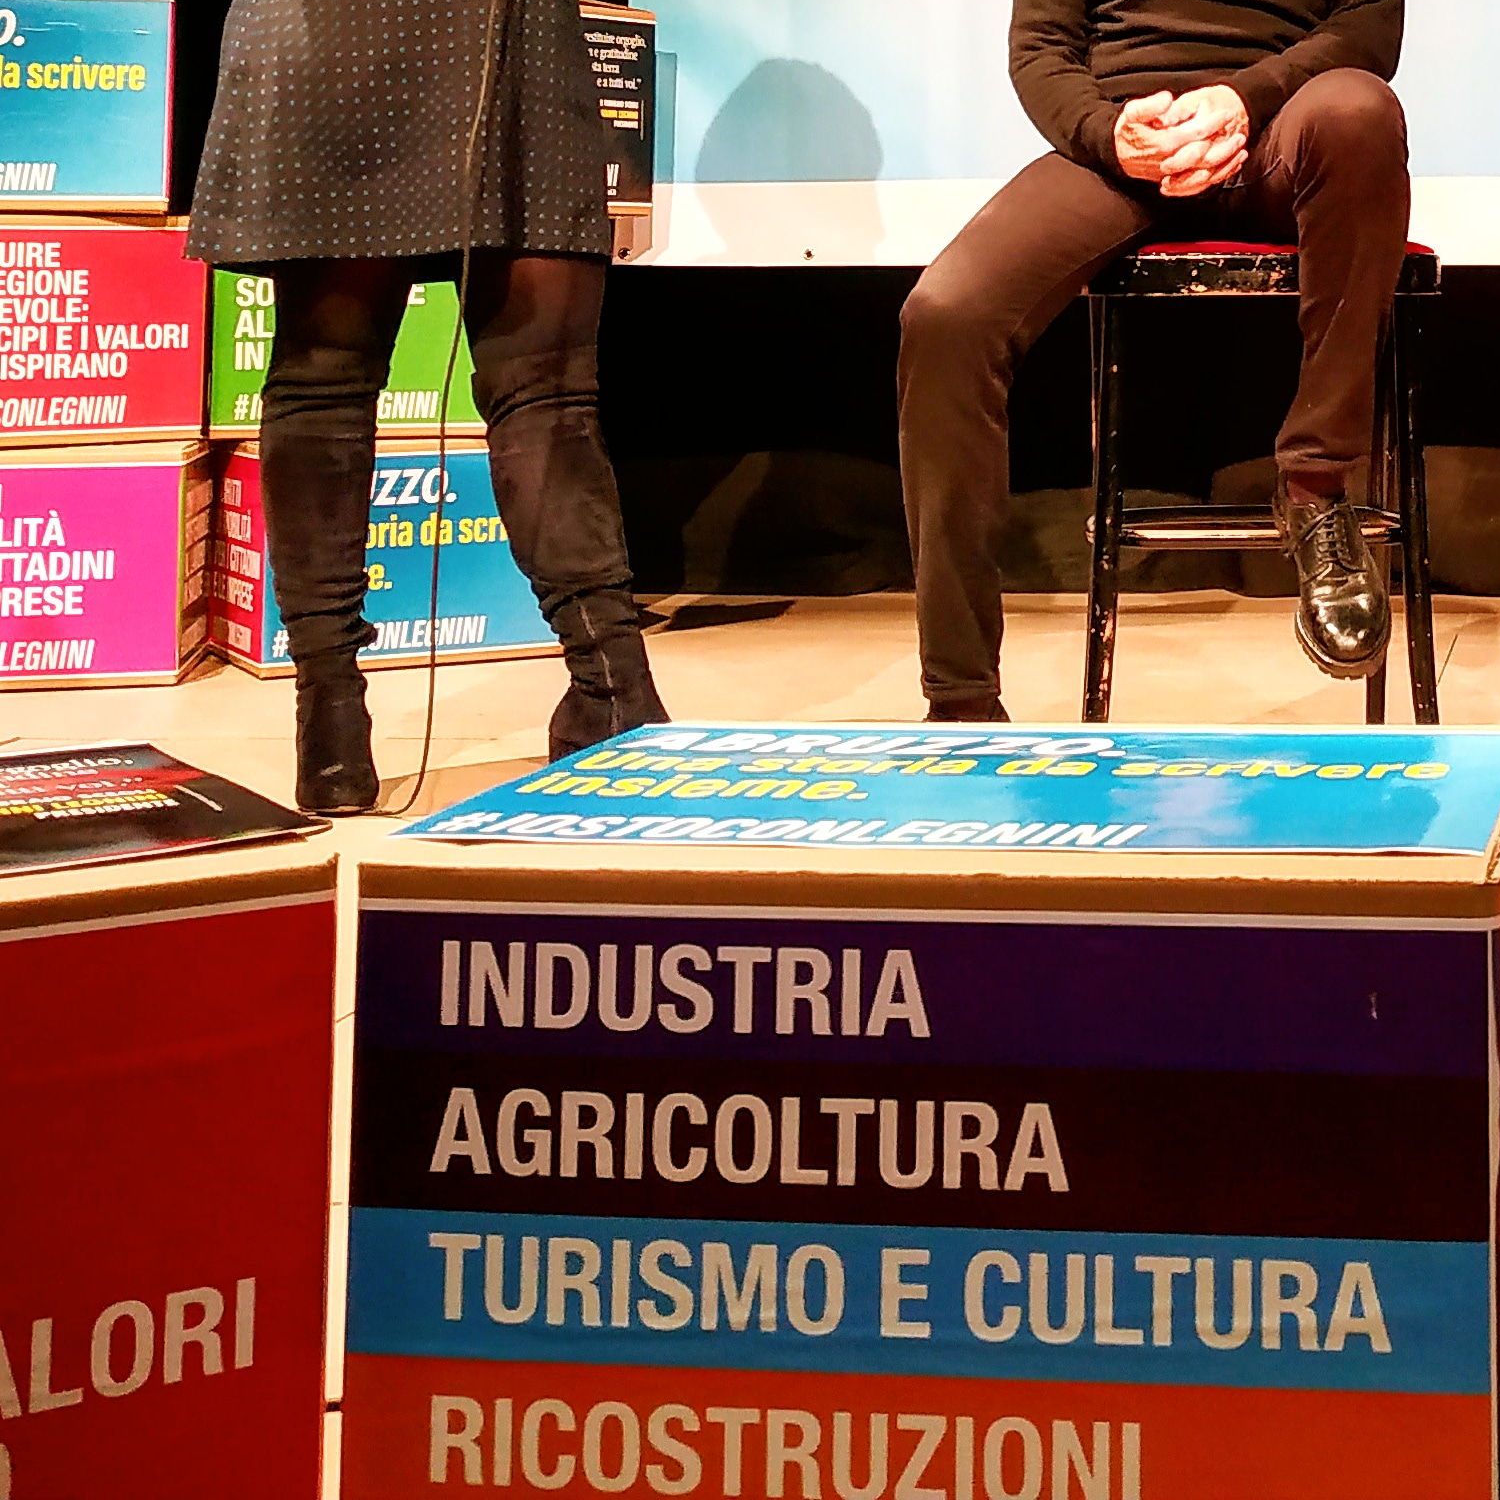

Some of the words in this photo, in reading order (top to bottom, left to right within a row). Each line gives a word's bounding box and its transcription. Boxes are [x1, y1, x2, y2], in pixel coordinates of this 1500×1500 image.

[27, 55, 146, 90] scrivere
[0, 298, 88, 323] EVOLE:
[234, 309, 275, 338] AL
[56, 326, 72, 351] E
[81, 325, 89, 350] I
[95, 324, 188, 350] VALORI
[1, 352, 128, 380] ISPIRANO
[234, 341, 264, 371] IN
[0, 395, 127, 427] ONLEGNINI
[617, 731, 1126, 756] ABRUZZO.
[573, 750, 732, 773] Una
[741, 753, 980, 775] storia
[995, 756, 1098, 777] da
[1112, 759, 1451, 780] scrivere
[515, 770, 870, 801] insieme.
[429, 810, 1148, 847] #IOSTOCONLEGNINI
[438, 938, 932, 1040] INDUSTRIA
[429, 1086, 1070, 1194] AGRICOLTURA
[429, 1230, 844, 1340] TURISMO
[881, 1246, 932, 1341] E
[965, 1247, 1393, 1355] CULTURA
[430, 1395, 1142, 1500] RICOSTRUZIONI
